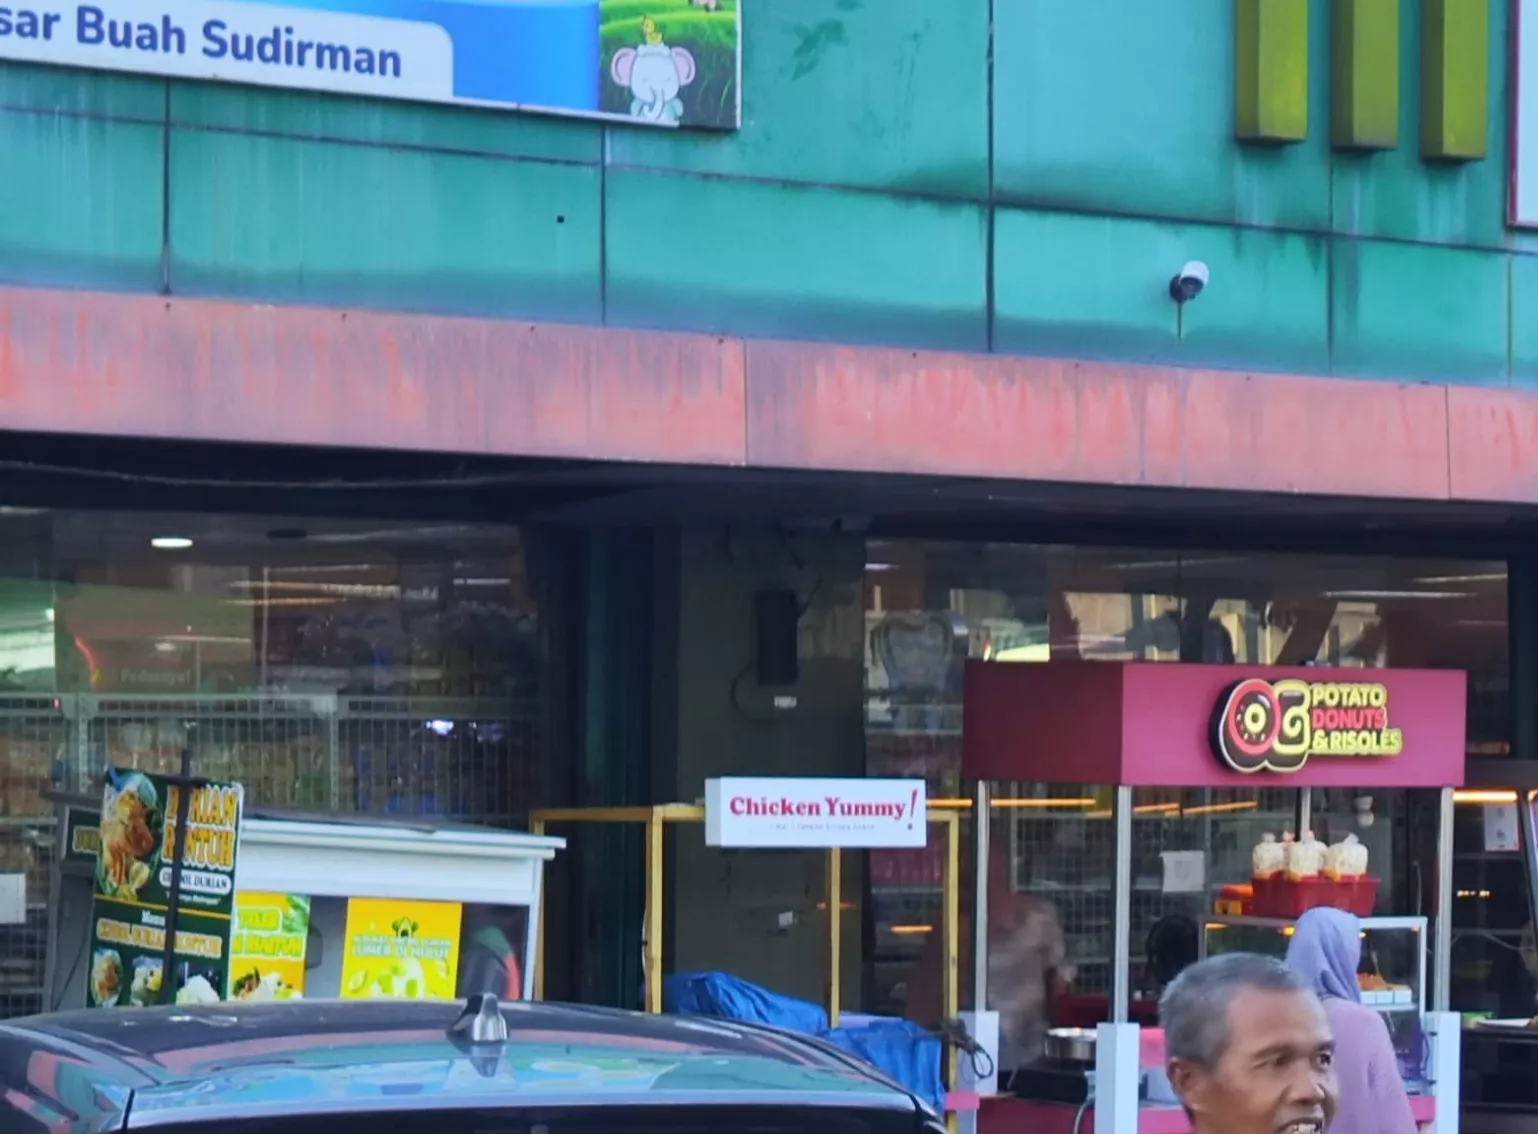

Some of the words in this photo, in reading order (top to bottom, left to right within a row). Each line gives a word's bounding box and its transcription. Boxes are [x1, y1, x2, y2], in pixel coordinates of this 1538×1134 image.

[76, 5, 186, 55] Buah
[201, 19, 402, 78] Sudirman
[1312, 686, 1386, 709] POTATO
[1312, 708, 1386, 729] DONUTS
[167, 784, 238, 826] DRIAN
[729, 796, 821, 817] Chicken
[162, 822, 236, 869] RNTUH
